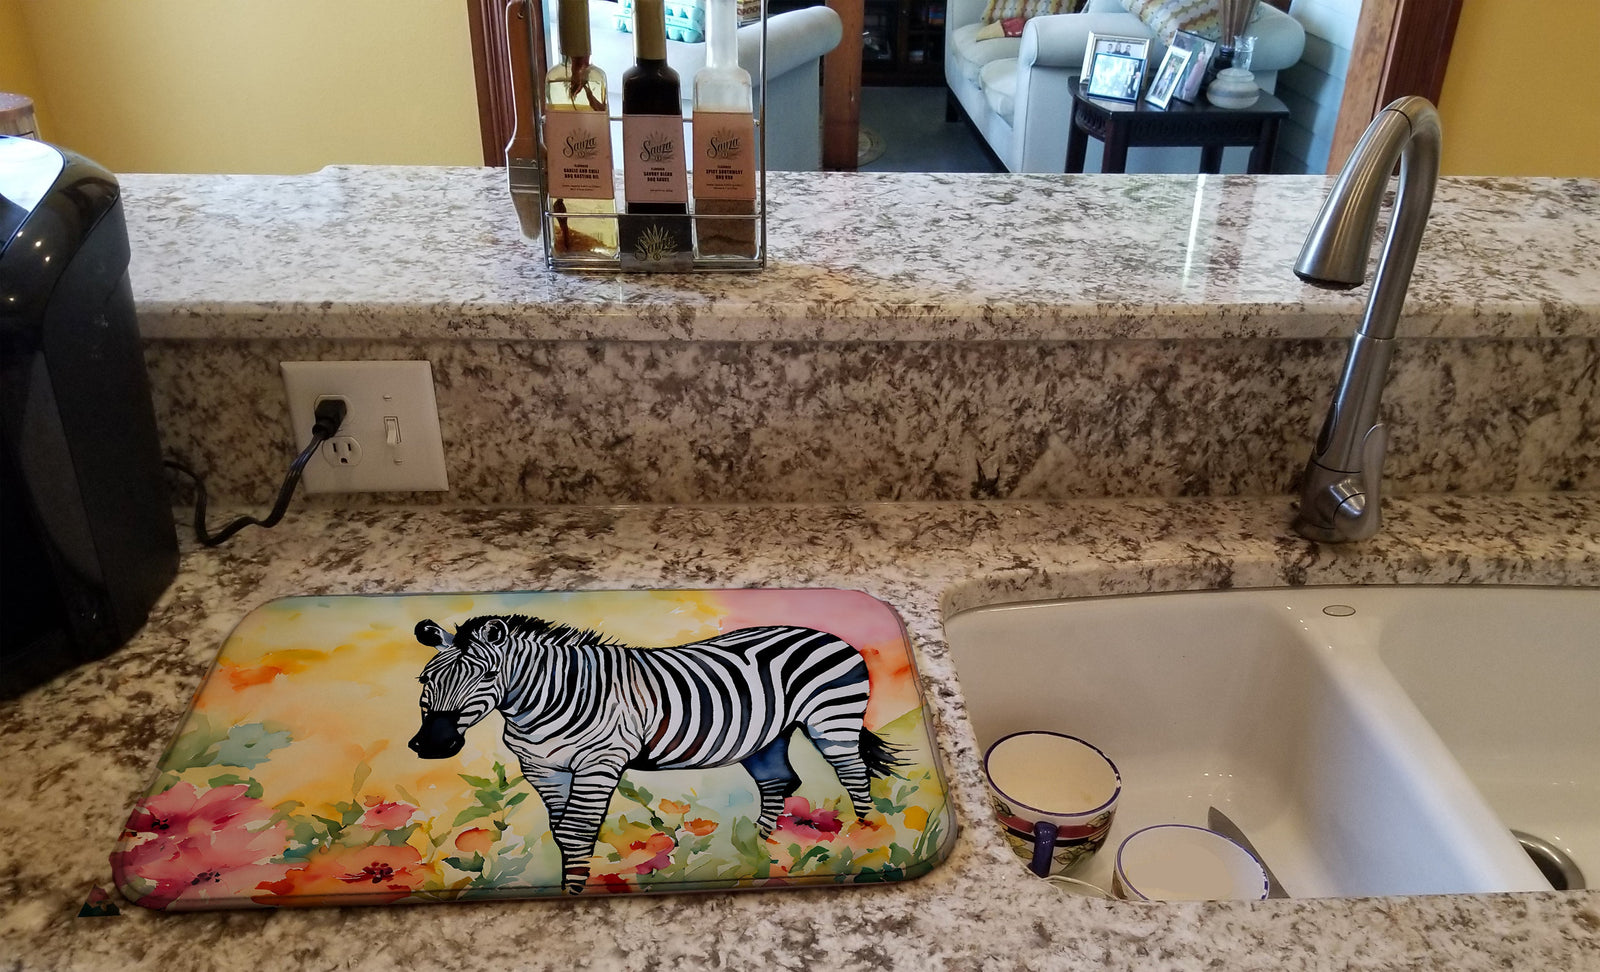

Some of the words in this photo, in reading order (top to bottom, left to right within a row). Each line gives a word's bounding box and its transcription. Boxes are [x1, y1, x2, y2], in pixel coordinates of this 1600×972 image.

[563, 136, 597, 158] Sauza
[640, 140, 673, 161] Sauza
[707, 136, 740, 158] Sauza
